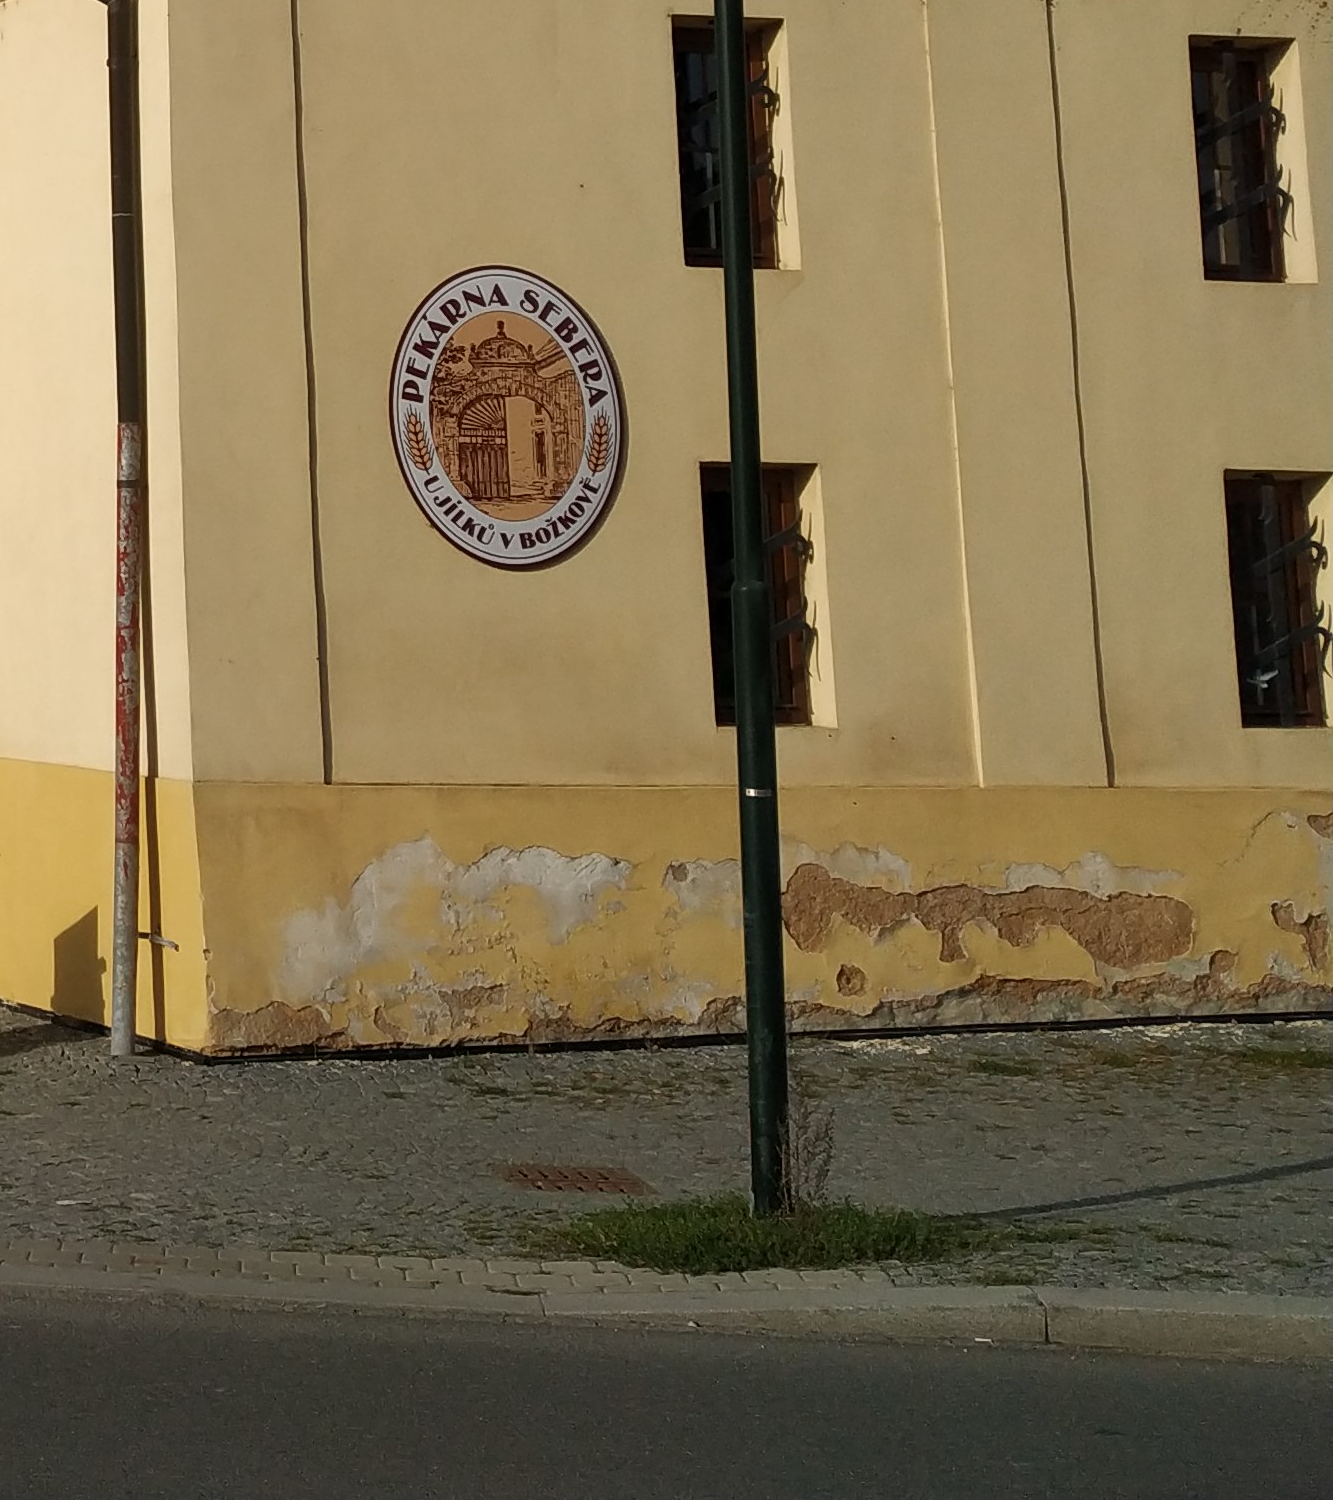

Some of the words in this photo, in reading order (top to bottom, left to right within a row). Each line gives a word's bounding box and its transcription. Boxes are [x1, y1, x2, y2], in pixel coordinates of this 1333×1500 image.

[401, 284, 510, 404] PEKÁRNA
[519, 289, 609, 409] SEBERA
[424, 475, 444, 494] U
[434, 495, 496, 546] JÍLKŮ
[500, 532, 515, 550] V
[519, 476, 602, 550] BOŽKOVĚ
